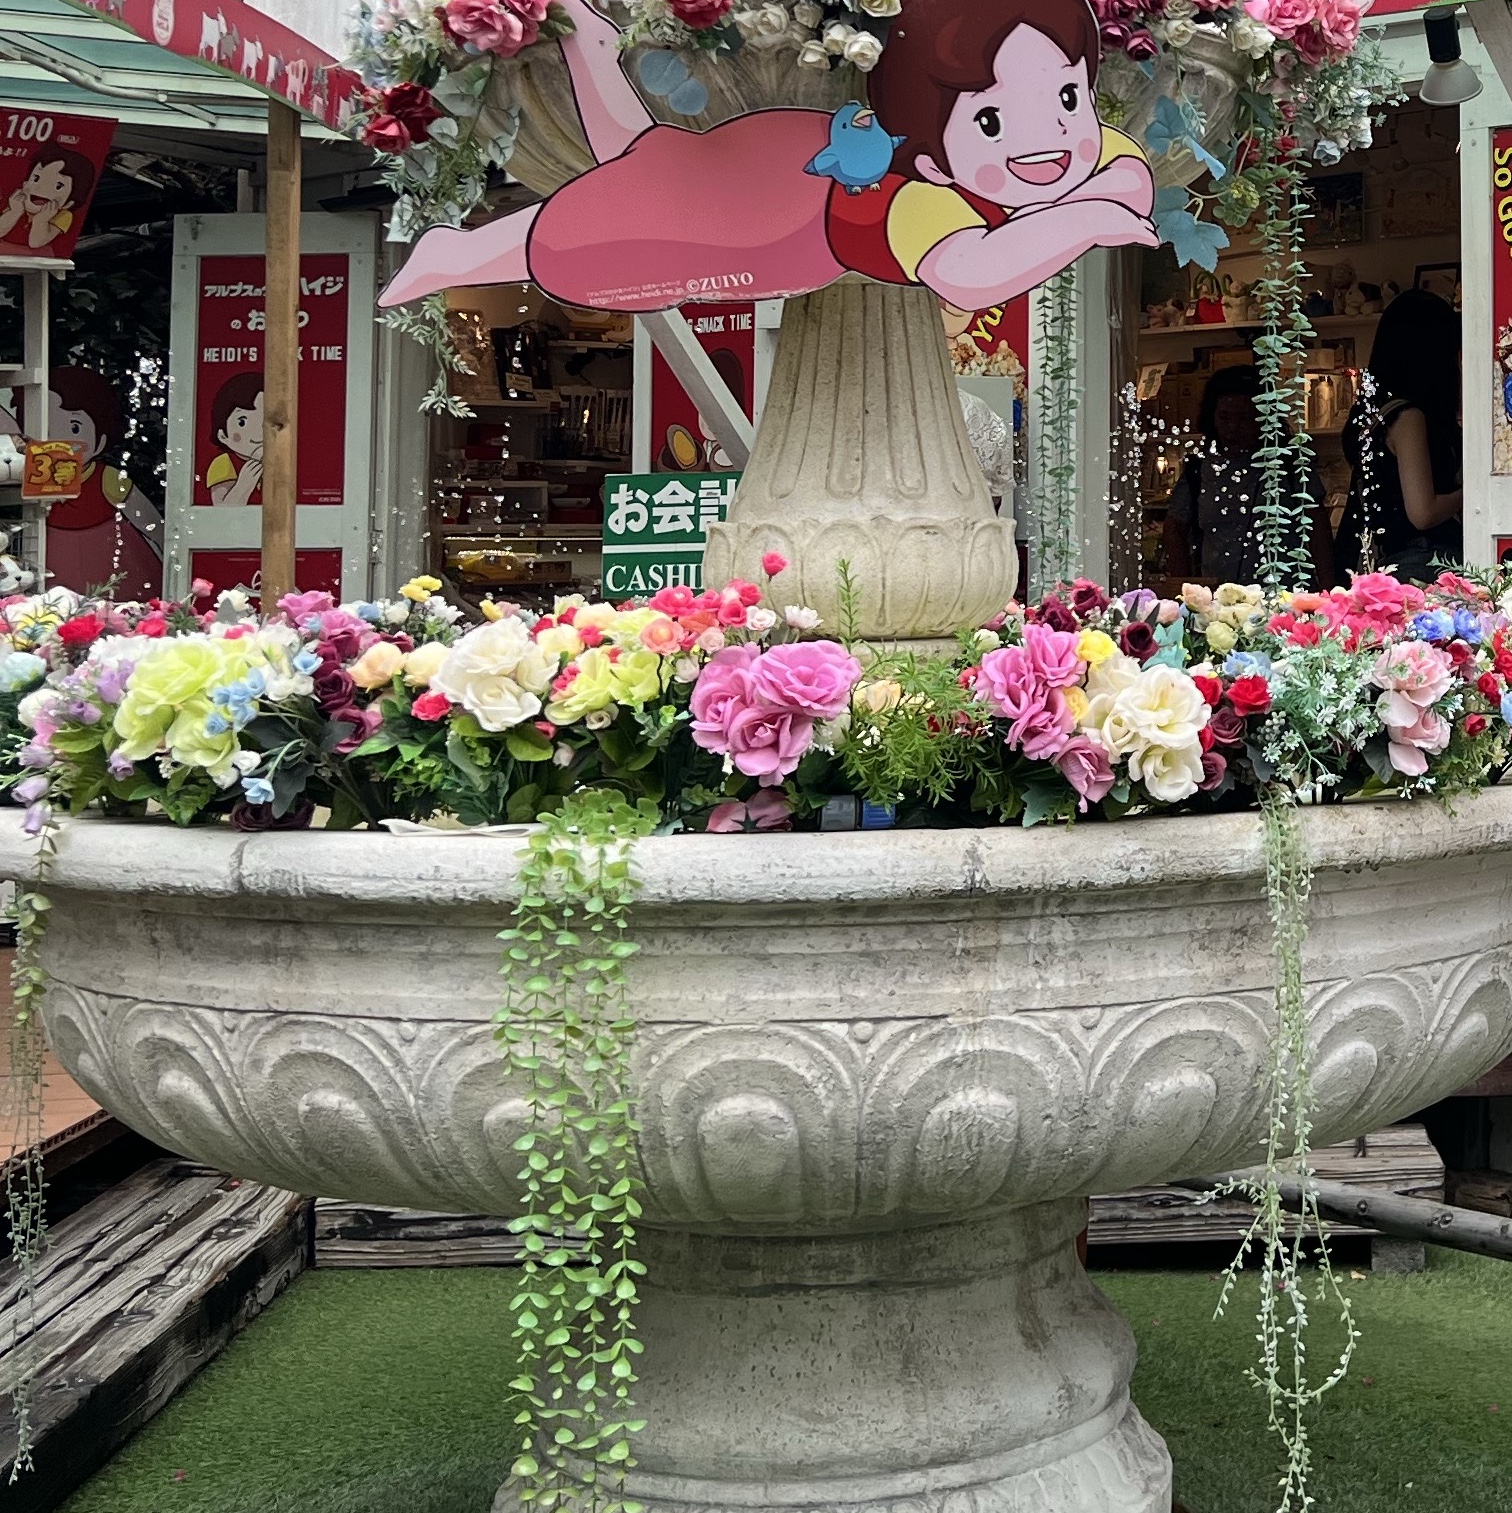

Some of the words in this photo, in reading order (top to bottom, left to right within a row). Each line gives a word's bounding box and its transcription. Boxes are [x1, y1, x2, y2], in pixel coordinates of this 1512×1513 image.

[6, 114, 54, 142] 100
[729, 313, 753, 331] TIME
[203, 346, 258, 363] HEIDI'S
[311, 345, 343, 362] TIME
[607, 478, 738, 535] お会計
[605, 562, 704, 592] CASHI
